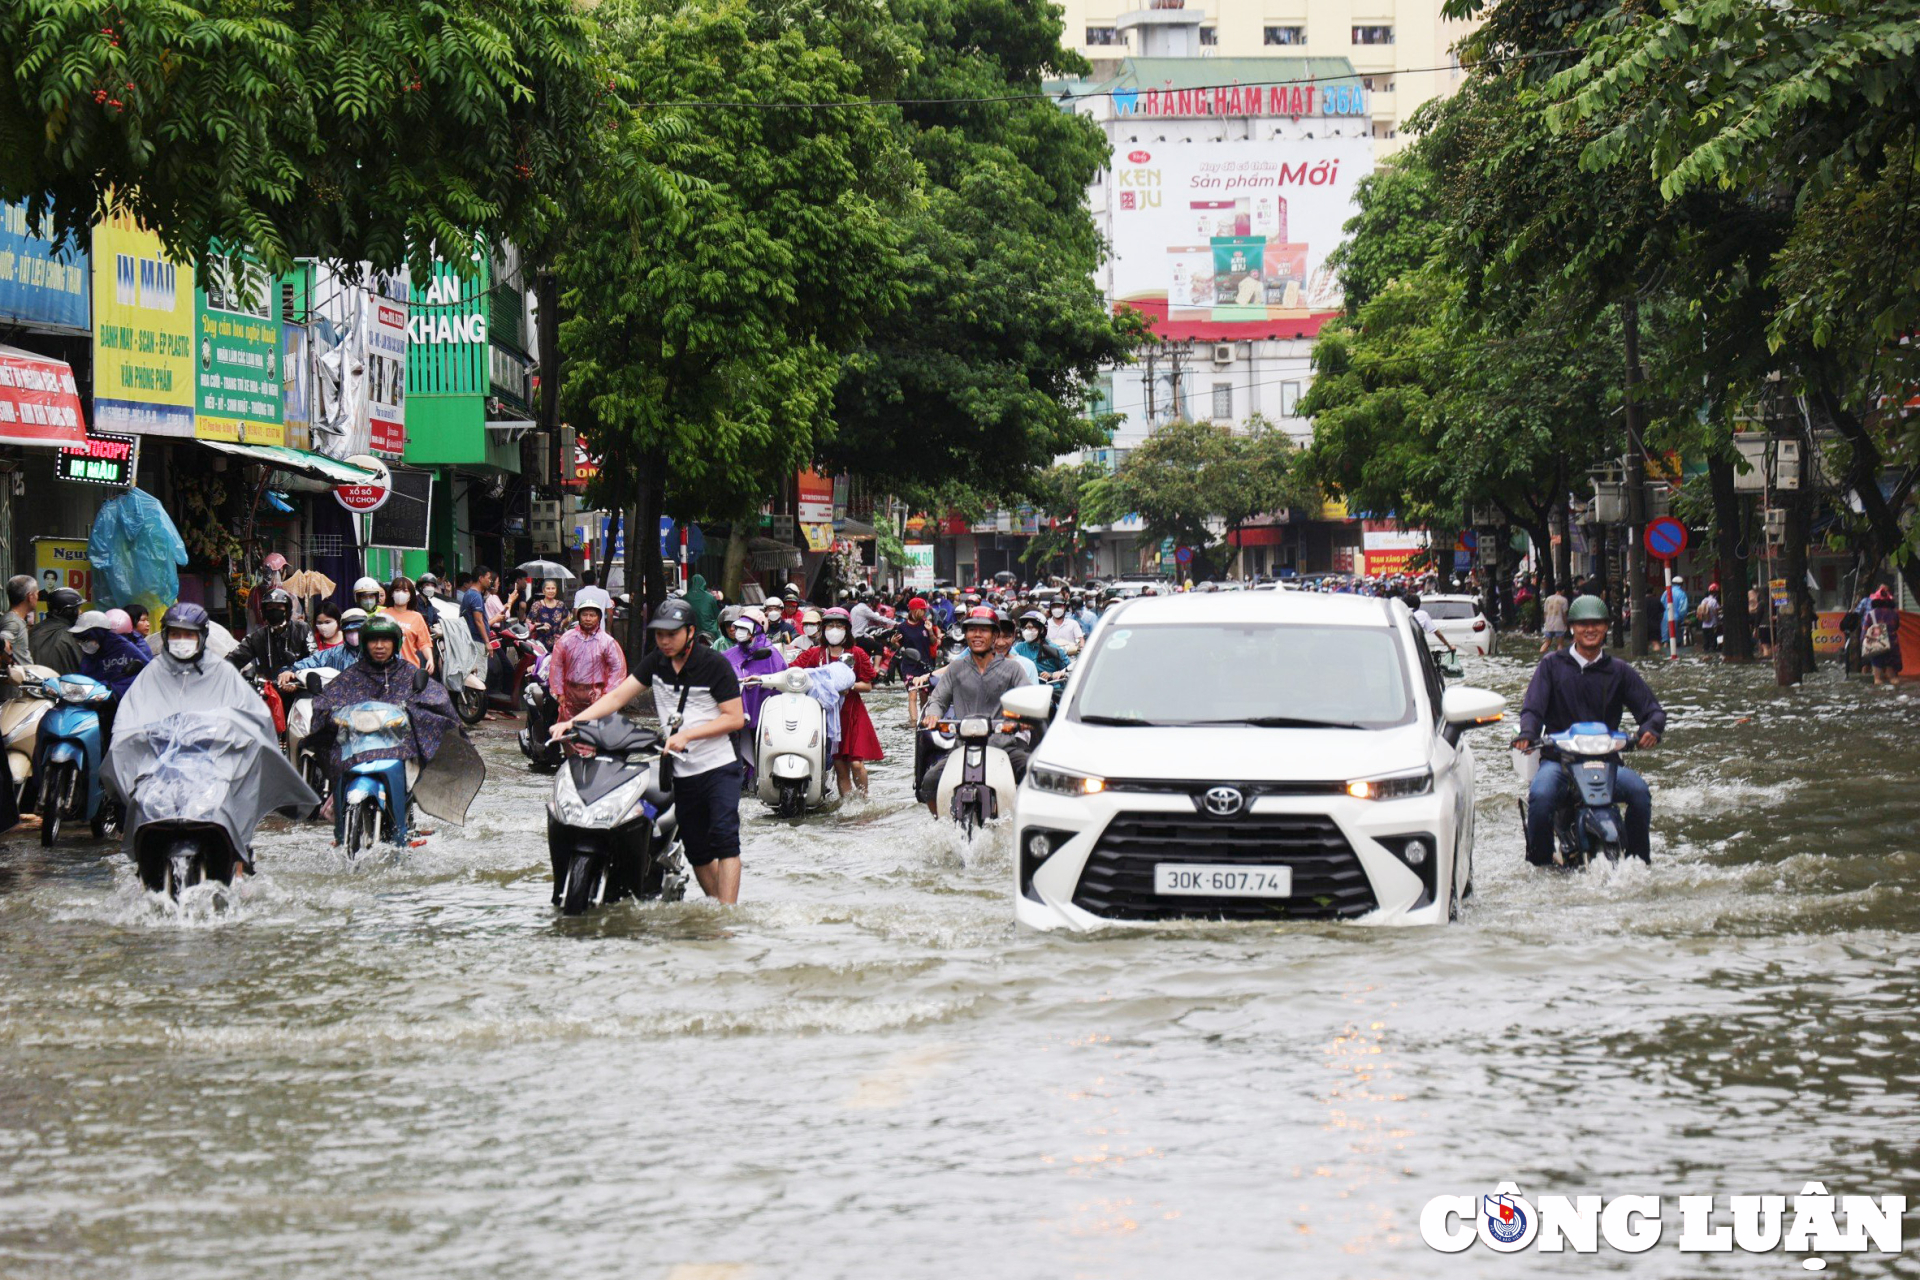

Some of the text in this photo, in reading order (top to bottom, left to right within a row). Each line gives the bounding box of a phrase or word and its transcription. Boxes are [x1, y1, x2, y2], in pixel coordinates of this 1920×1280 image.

[1147, 79, 1207, 115] RĂNG
[1214, 78, 1262, 115] HÀM
[1323, 86, 1365, 116] 36A
[1119, 169, 1162, 187] KEN
[1190, 158, 1340, 190] Sản phẩm Mới
[1139, 190, 1162, 210] JU
[117, 250, 176, 312] IN MÀU
[426, 275, 459, 304] AN
[233, 319, 244, 338] hoa
[406, 313, 486, 344] KHANG
[138, 329, 155, 353] SCAN
[167, 333, 189, 358] PLASTIC
[70, 459, 118, 480] IN MÀU
[1167, 871, 1279, 891] 30K-607.74
